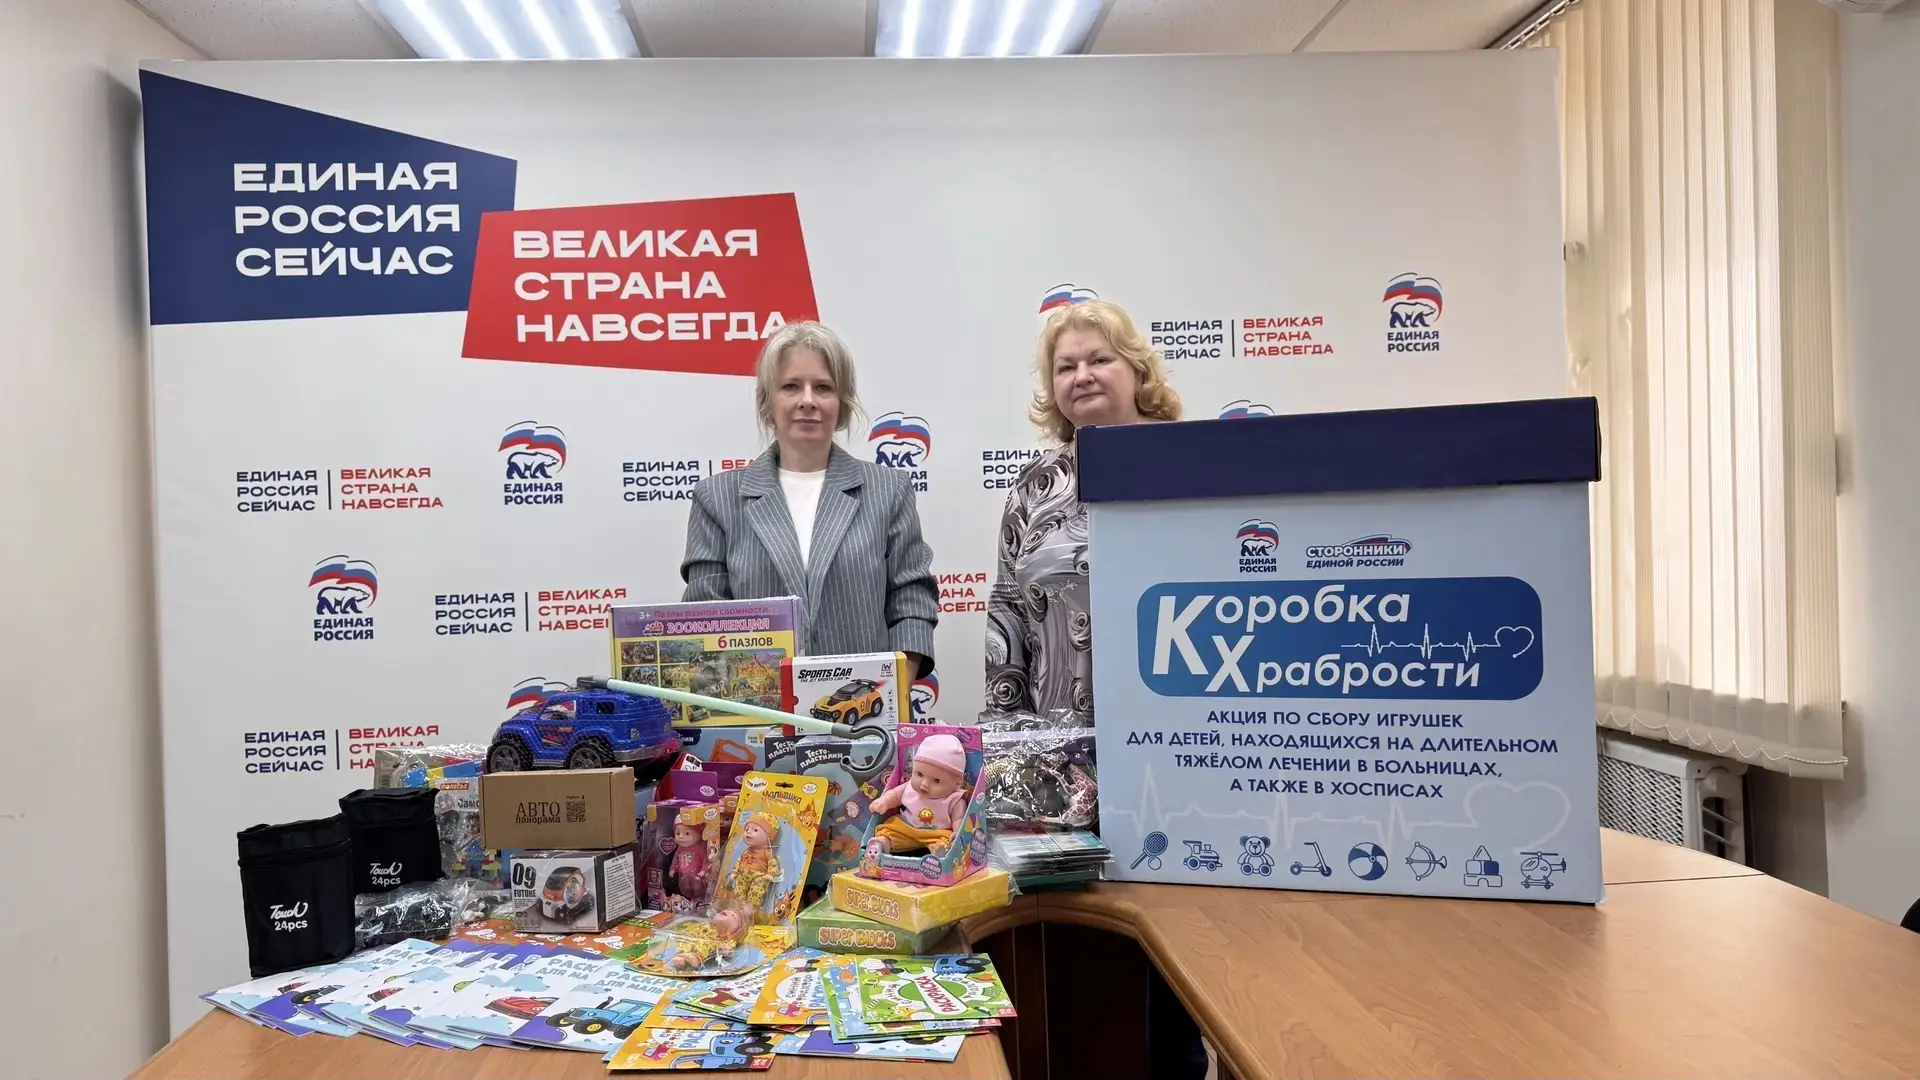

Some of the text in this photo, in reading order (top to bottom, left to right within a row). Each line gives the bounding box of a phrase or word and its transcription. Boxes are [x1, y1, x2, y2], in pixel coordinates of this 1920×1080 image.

[233, 161, 458, 194] ЕДИНАЯ
[234, 203, 461, 235] РОССИЯ
[513, 229, 758, 260] ВЕЛИКАЯ
[235, 241, 454, 277] СЕЙЧАС
[514, 270, 727, 301] СТРАНА
[516, 311, 786, 343] НАВСЕГДА
[1151, 319, 1223, 333] ЕДИНАЯ
[1243, 316, 1324, 329] ВЕЛИКАЯ
[1151, 333, 1223, 346] РОССИЯ
[1243, 331, 1312, 343] СТРАНА
[1387, 331, 1440, 342] ЕДИНАЯ
[1163, 347, 1221, 360] ЕЙЧАС
[1243, 344, 1334, 357] НАВСЕГДА
[1387, 342, 1440, 353] РОССИЯ
[982, 448, 1047, 461] ЕДИНА
[622, 460, 700, 473] ЕДИНАЯ
[983, 464, 1026, 475] РОС
[236, 469, 318, 484] ЕДИНАЯ
[340, 467, 431, 480] ВЕЛИКАЯ
[503, 482, 563, 493] ЕДИНАЯ
[622, 475, 701, 488] РОССИЯ
[983, 477, 1015, 489] СЕЙ
[236, 485, 319, 498] РОССИЯ
[340, 482, 419, 495] СТРАНА
[236, 498, 316, 513] СЕЙЧАС
[341, 496, 444, 510] НАВСЕГДА
[503, 493, 564, 506] РОССИЯ
[1306, 544, 1404, 558] СТОРОННИКИ
[1238, 558, 1277, 566] ЕДИНАЯ
[1306, 557, 1404, 570] ЕДИНОЙ РОССИИ
[1239, 565, 1277, 573] РОССИЯ
[434, 592, 515, 606] ЕДИНАЯ
[538, 588, 627, 602] ВЕЛИКАЯ
[939, 587, 975, 599] АНА
[435, 607, 516, 621] РОССИЯ
[538, 603, 612, 616] СТРАНА
[313, 618, 374, 630] ЕДИНАЯ
[435, 621, 513, 636] СЕЙЧАС
[538, 618, 609, 631] НАВСЕ
[666, 618, 770, 634] ЗООКОЛЛЕКЦИЯ
[1152, 584, 1410, 675] Коробка
[313, 629, 374, 642] РОССИЯ
[717, 635, 773, 649] 6 ПАЗЛОВ
[1205, 634, 1481, 694] Храбрости
[798, 667, 853, 680] SPORTS CAR
[1206, 710, 1464, 728] АКЦИЯ ПО СБОРУ ИГРУШЕК
[244, 729, 326, 744] ЕДИНАЯ
[348, 725, 439, 739] ВЕЛИКАЯ
[1126, 730, 1559, 754] ДЛЯ ДЕТЕЙ, НАХОДЯЩИХСЯ НА ДЛИТЕЛЬНОМ
[244, 744, 327, 759] РОССИЯ
[805, 749, 830, 759] Тесто-
[245, 758, 324, 774] СЕЙЧАС
[800, 753, 843, 768] пластилин
[1174, 750, 1503, 779] ТЯЖЁЛОМ ЛЕЧЕНИИ В БОЛЬНИЦАХ,
[1229, 778, 1444, 799] А ТАКЖЕ В ХОСПИСАХ
[516, 801, 561, 817] АВТО
[515, 815, 561, 825] панорама
[371, 876, 401, 887] 24pcs
[512, 862, 537, 889] 09
[513, 889, 537, 898] FUTURE
[274, 920, 308, 932] 24pcs
[914, 975, 960, 1013] РАСКРАСКА
